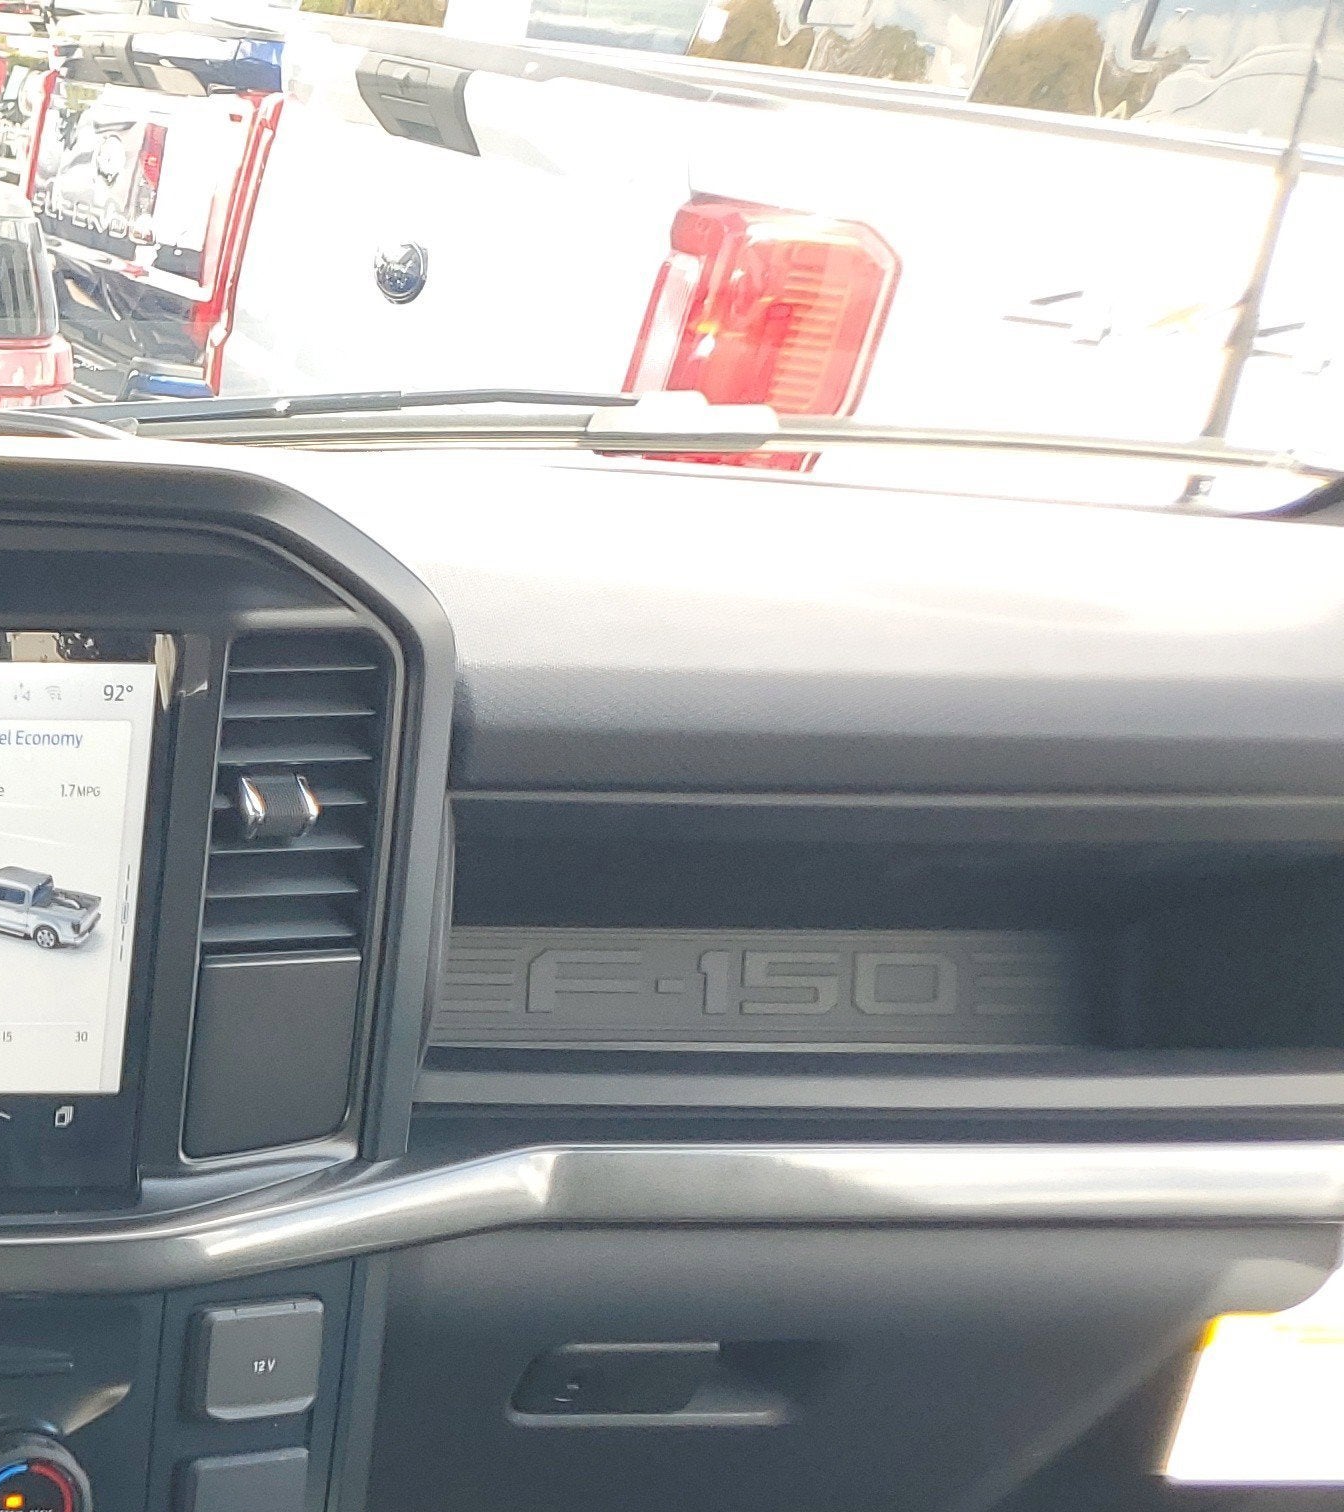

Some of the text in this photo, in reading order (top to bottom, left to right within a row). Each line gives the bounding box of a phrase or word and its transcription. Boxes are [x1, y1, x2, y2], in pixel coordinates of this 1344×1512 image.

[103, 684, 134, 701] 92°
[15, 730, 84, 748] Economy
[524, 946, 960, 1017] F-150
[2, 1031, 12, 1043] 15
[75, 1031, 88, 1043] 30
